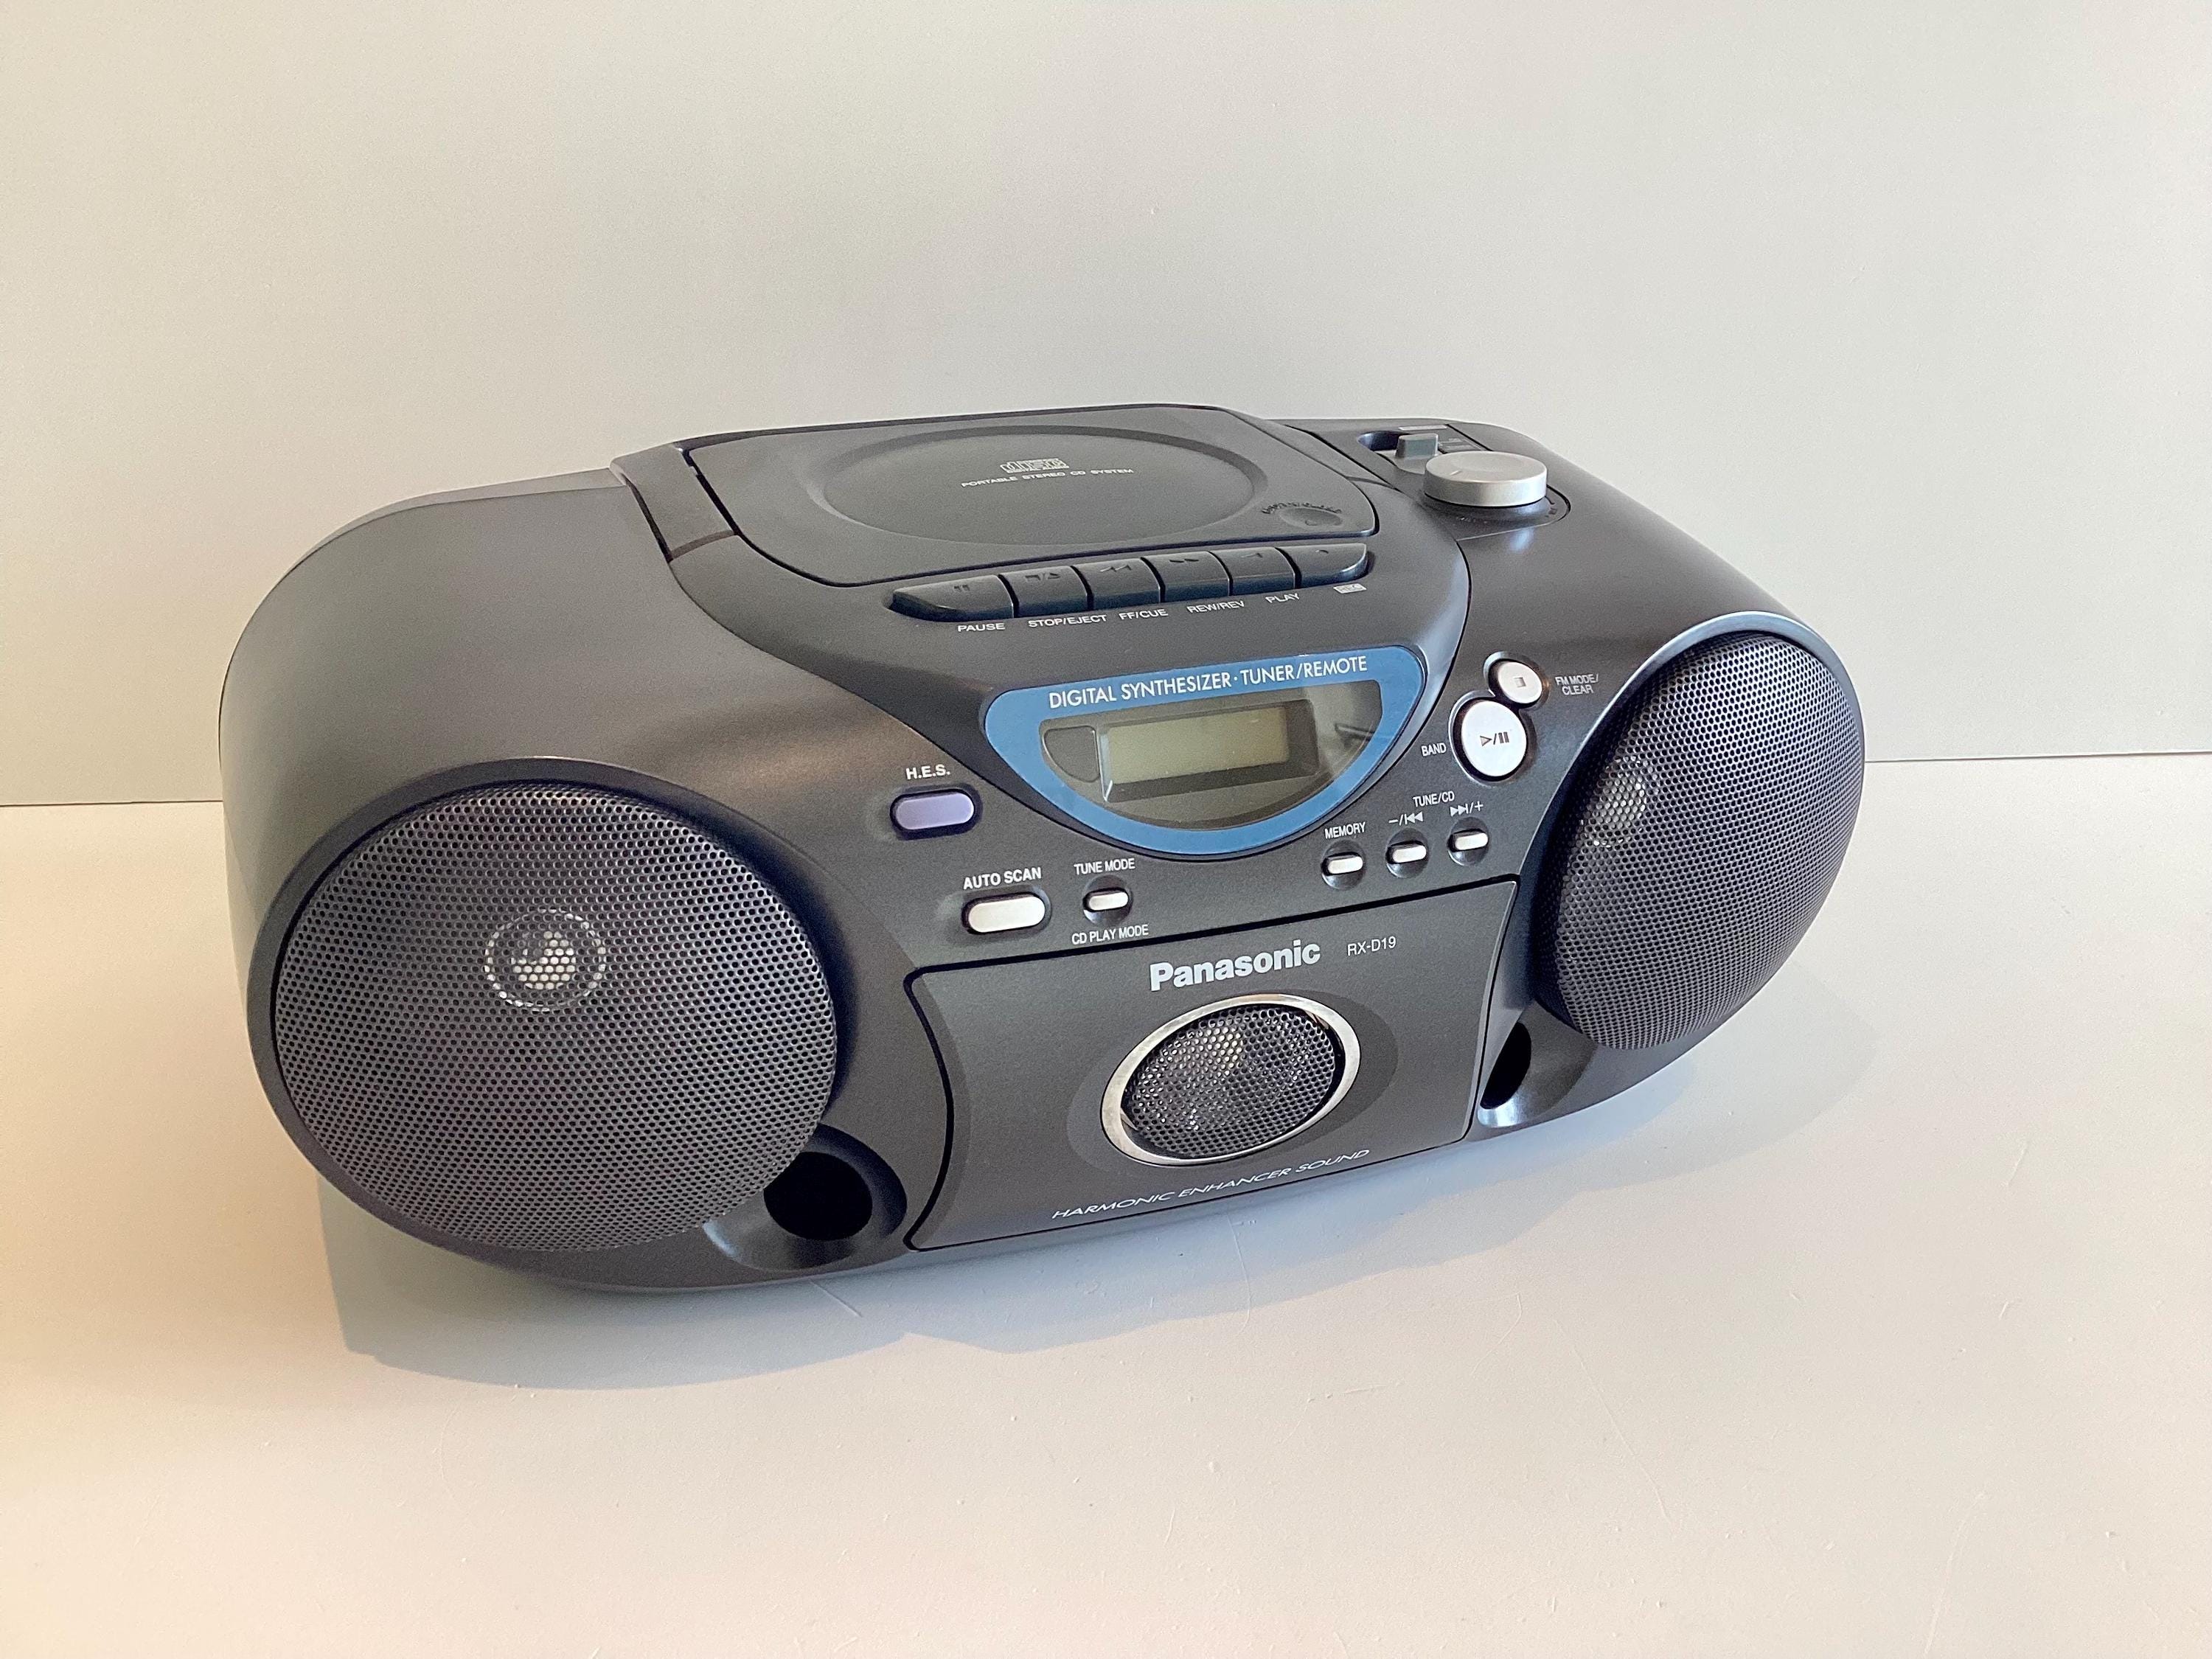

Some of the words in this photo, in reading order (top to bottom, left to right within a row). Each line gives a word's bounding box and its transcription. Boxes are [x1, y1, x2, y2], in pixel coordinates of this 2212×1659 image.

[1022, 472, 1066, 480] STEREO
[1265, 592, 1300, 603] PLAY
[1119, 608, 1169, 620] FF/CUE
[1186, 600, 1245, 613] REW/REV
[957, 622, 1006, 632] PAUSE
[1028, 614, 1107, 627] STOP/EJECT
[1555, 676, 1570, 686] FM
[1570, 673, 1599, 685] MODE/
[1048, 685, 1117, 709] DIGITAL
[1562, 684, 1594, 695] CLEAR
[1421, 742, 1447, 757] BAND
[905, 764, 951, 780] H.E.S.
[1412, 790, 1455, 807] TUNE/CD
[1324, 821, 1366, 839] MEMORY
[1073, 860, 1103, 875] TUNE
[1105, 858, 1135, 872] MODE
[963, 872, 1001, 890] AUTO
[1004, 866, 1042, 884] SCAN
[1071, 932, 1088, 945] CD
[1089, 928, 1116, 943] PLAY
[1119, 924, 1149, 939] MODE
[1347, 936, 1397, 956] RX-D19
[1150, 939, 1321, 992] Panasonic
[1051, 1192, 1175, 1219] HARMONIC
[1178, 1167, 1292, 1197] ENHANCER
[1295, 1150, 1370, 1172] SOUND
